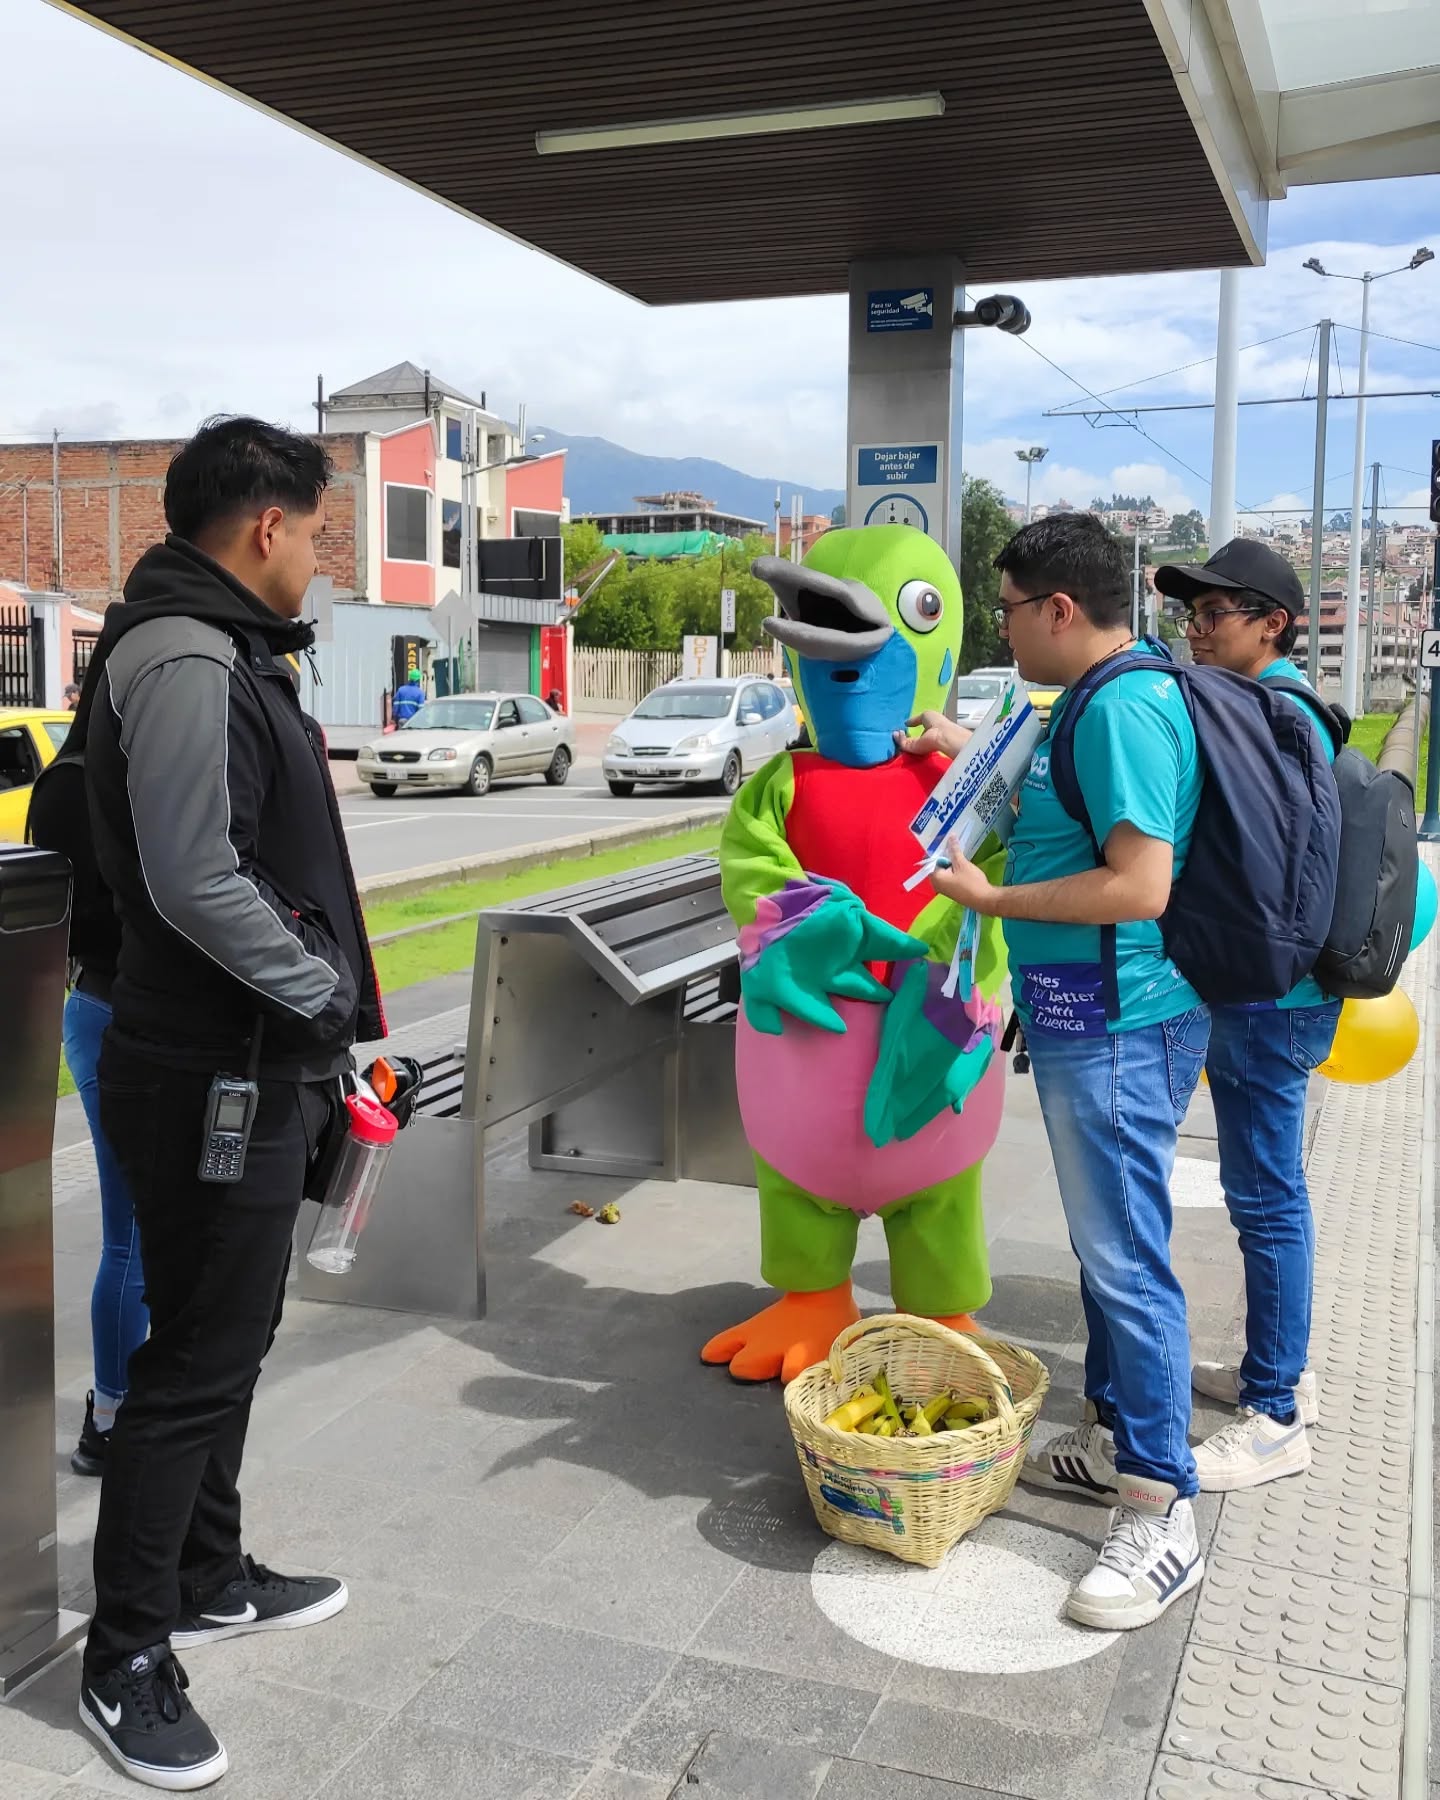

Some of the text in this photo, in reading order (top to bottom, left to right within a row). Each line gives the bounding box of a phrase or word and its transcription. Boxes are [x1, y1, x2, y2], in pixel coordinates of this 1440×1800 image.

[871, 307, 900, 316] seguridad
[874, 451, 920, 462] Dejar bajar
[880, 461, 915, 471] antes de
[886, 472, 908, 481] subir
[1126, 1488, 1164, 1504] adidas
